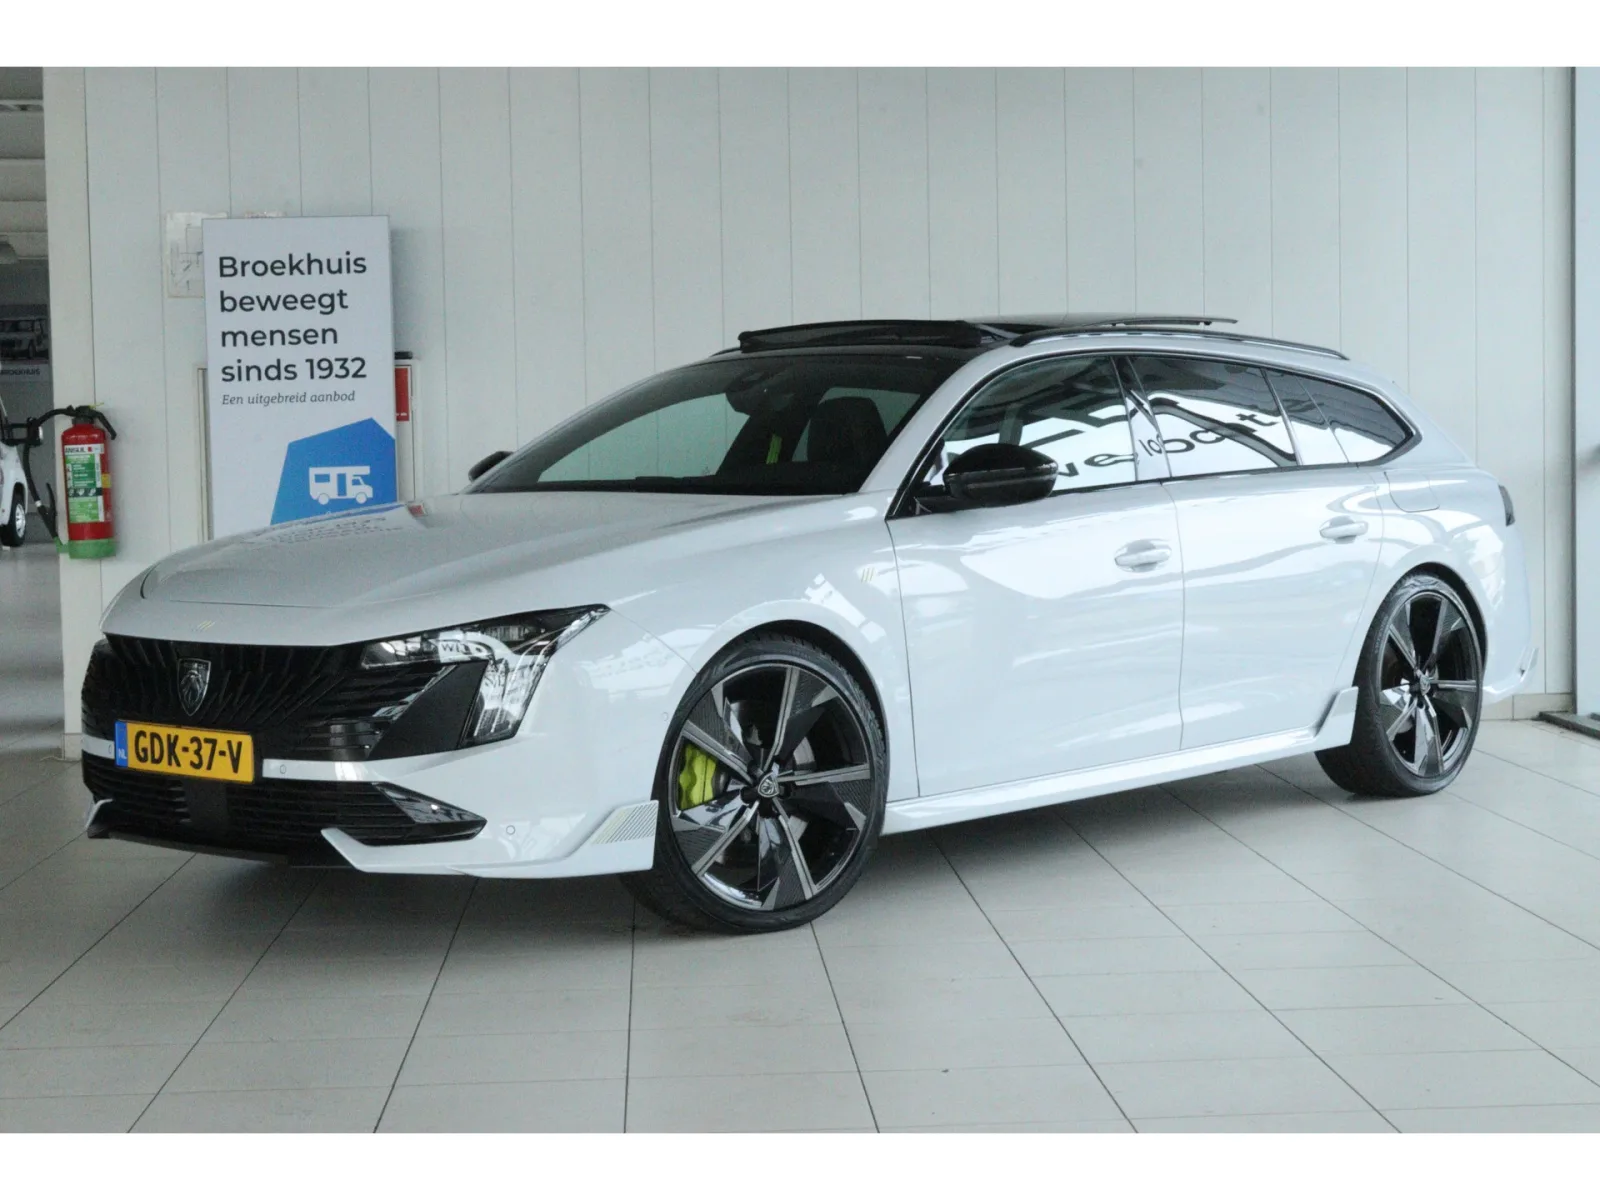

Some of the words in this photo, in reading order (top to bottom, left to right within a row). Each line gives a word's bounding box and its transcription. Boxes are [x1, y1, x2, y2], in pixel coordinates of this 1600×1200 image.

[218, 250, 367, 278] Broekhuis
[219, 289, 349, 316] beweegt
[221, 327, 338, 348] mensen
[221, 358, 298, 383] sinds
[305, 356, 367, 380] 1932
[221, 394, 244, 405] Een
[247, 391, 307, 407] uitgebreid
[310, 390, 356, 403] aanbod
[134, 730, 243, 774] GDK-37-V
